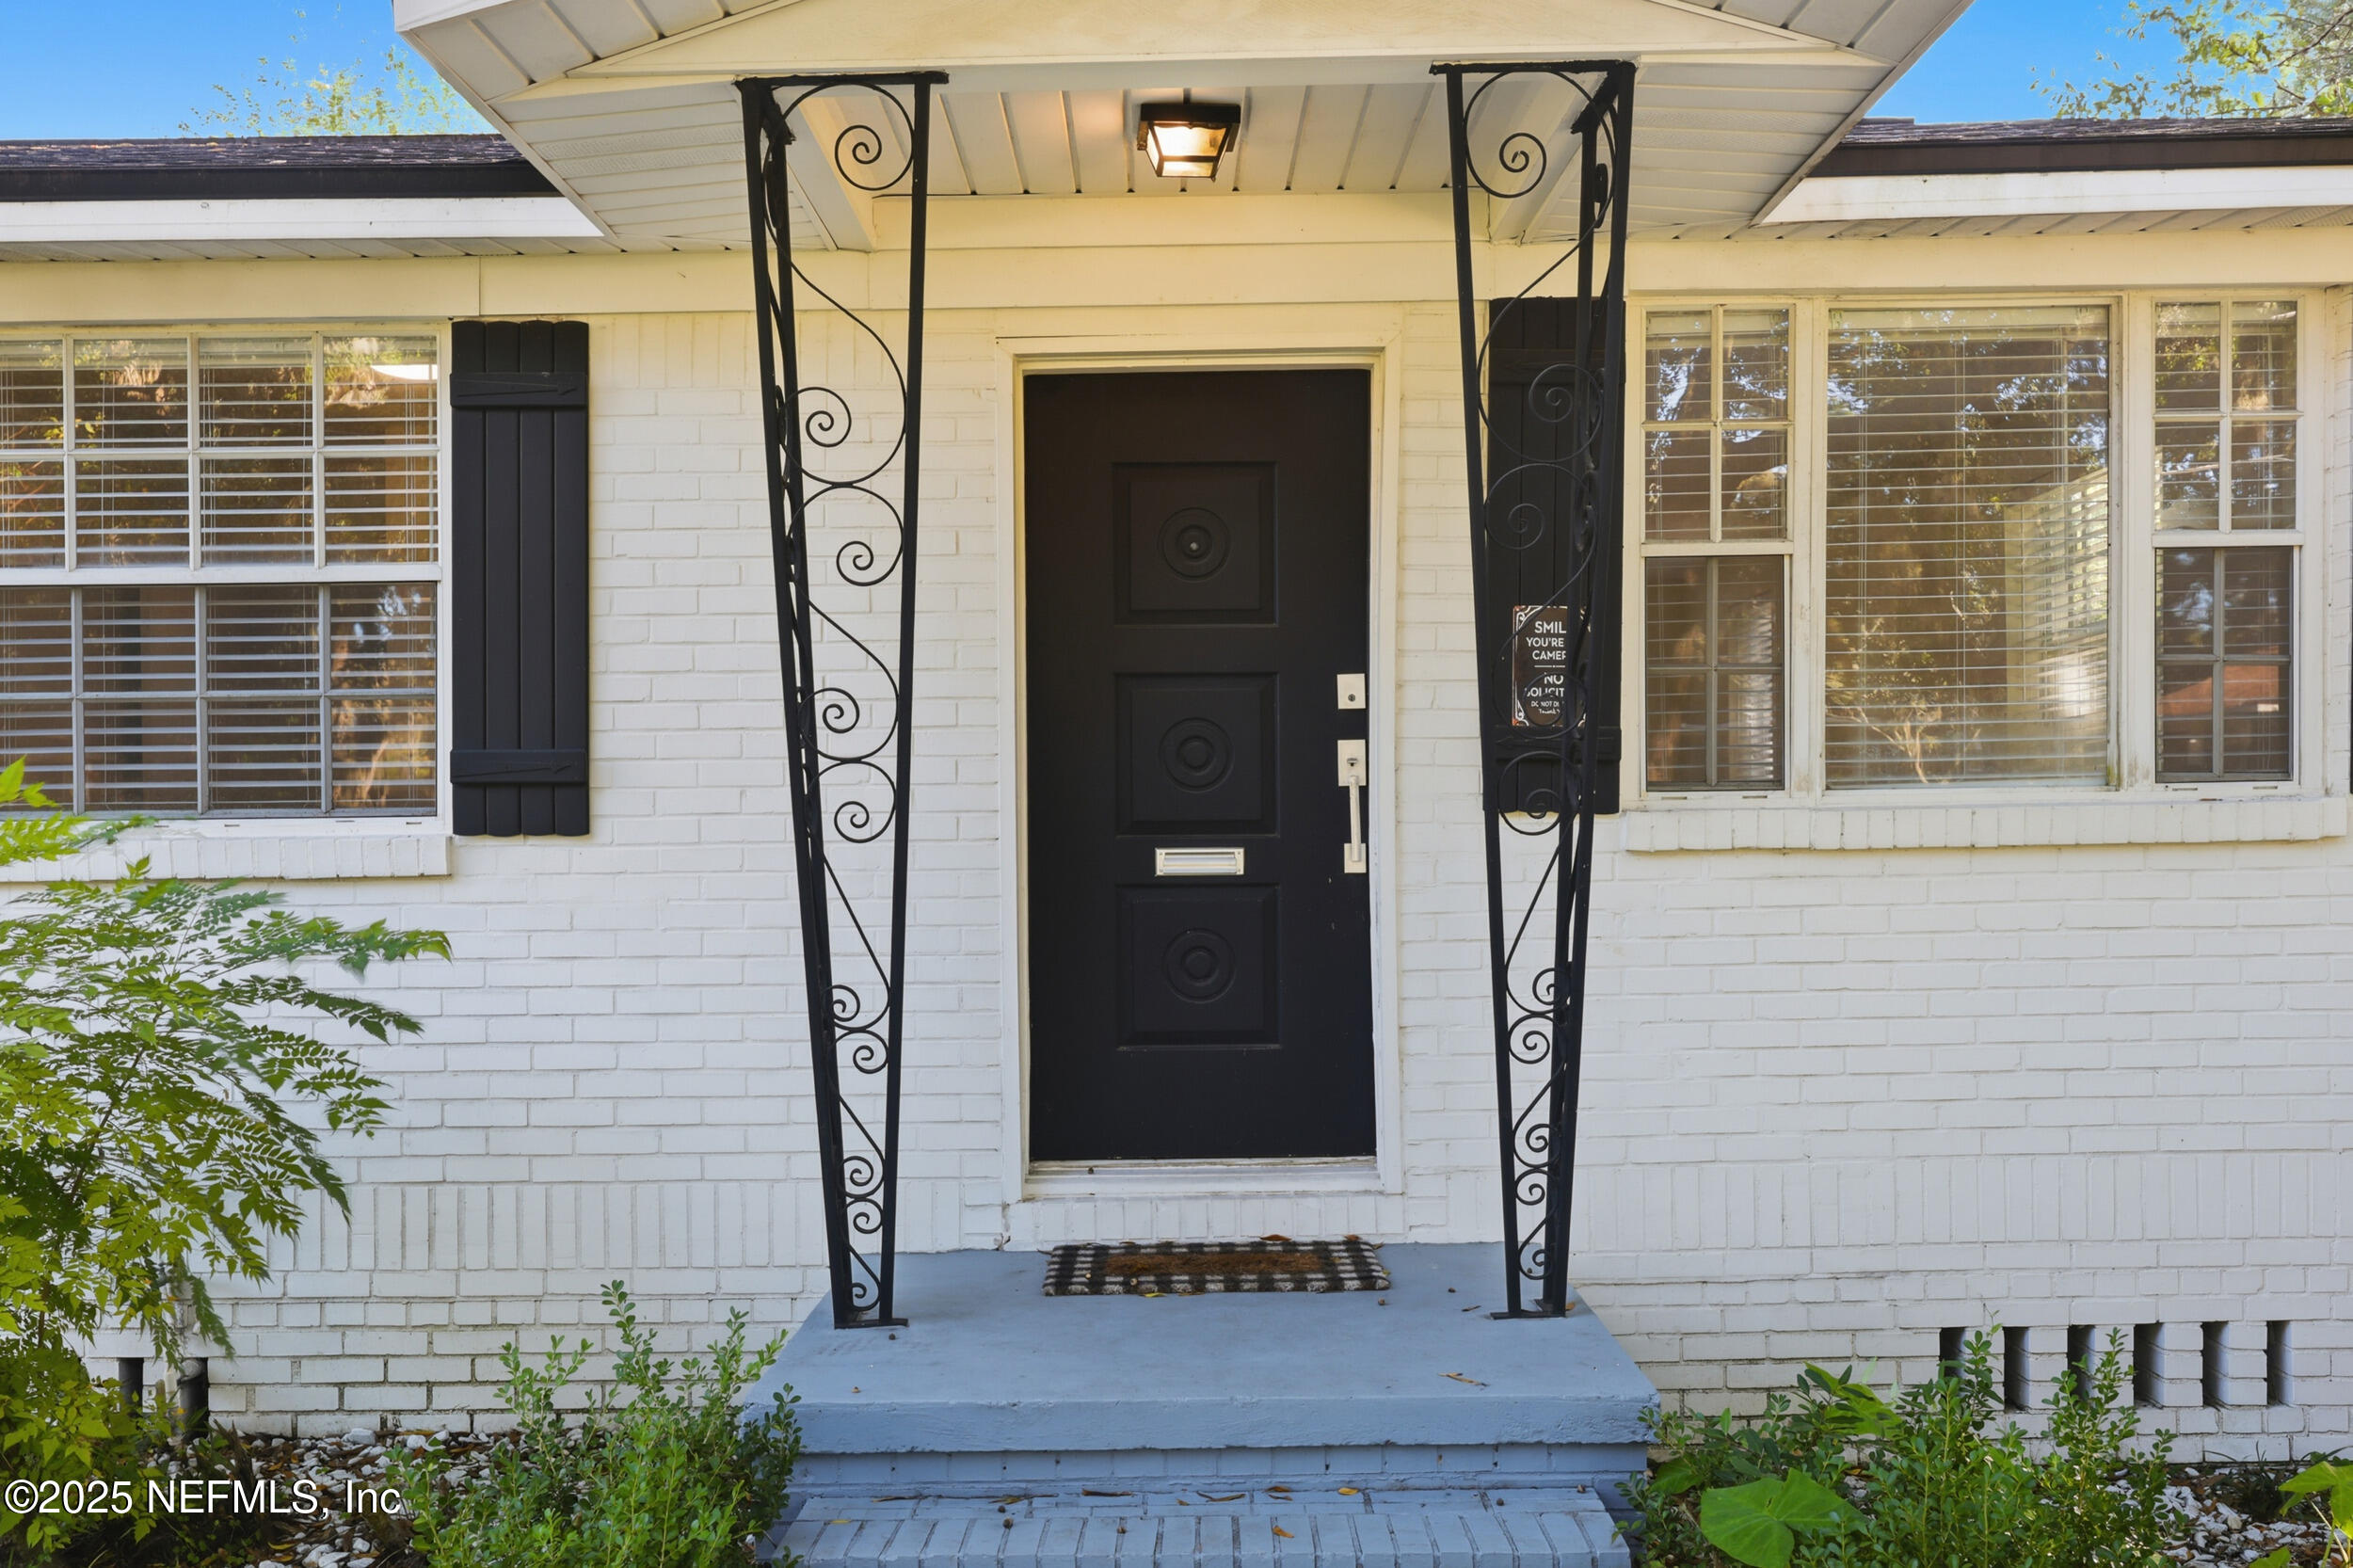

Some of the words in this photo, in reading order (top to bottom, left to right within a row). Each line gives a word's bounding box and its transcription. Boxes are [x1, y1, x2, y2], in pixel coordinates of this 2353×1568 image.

[1534, 621, 1567, 633] SMIL
[1526, 637, 1564, 648] YOU'RE
[1532, 650, 1566, 660] CAMER
[1544, 672, 1564, 685] NO
[1525, 687, 1564, 697] OLICIT
